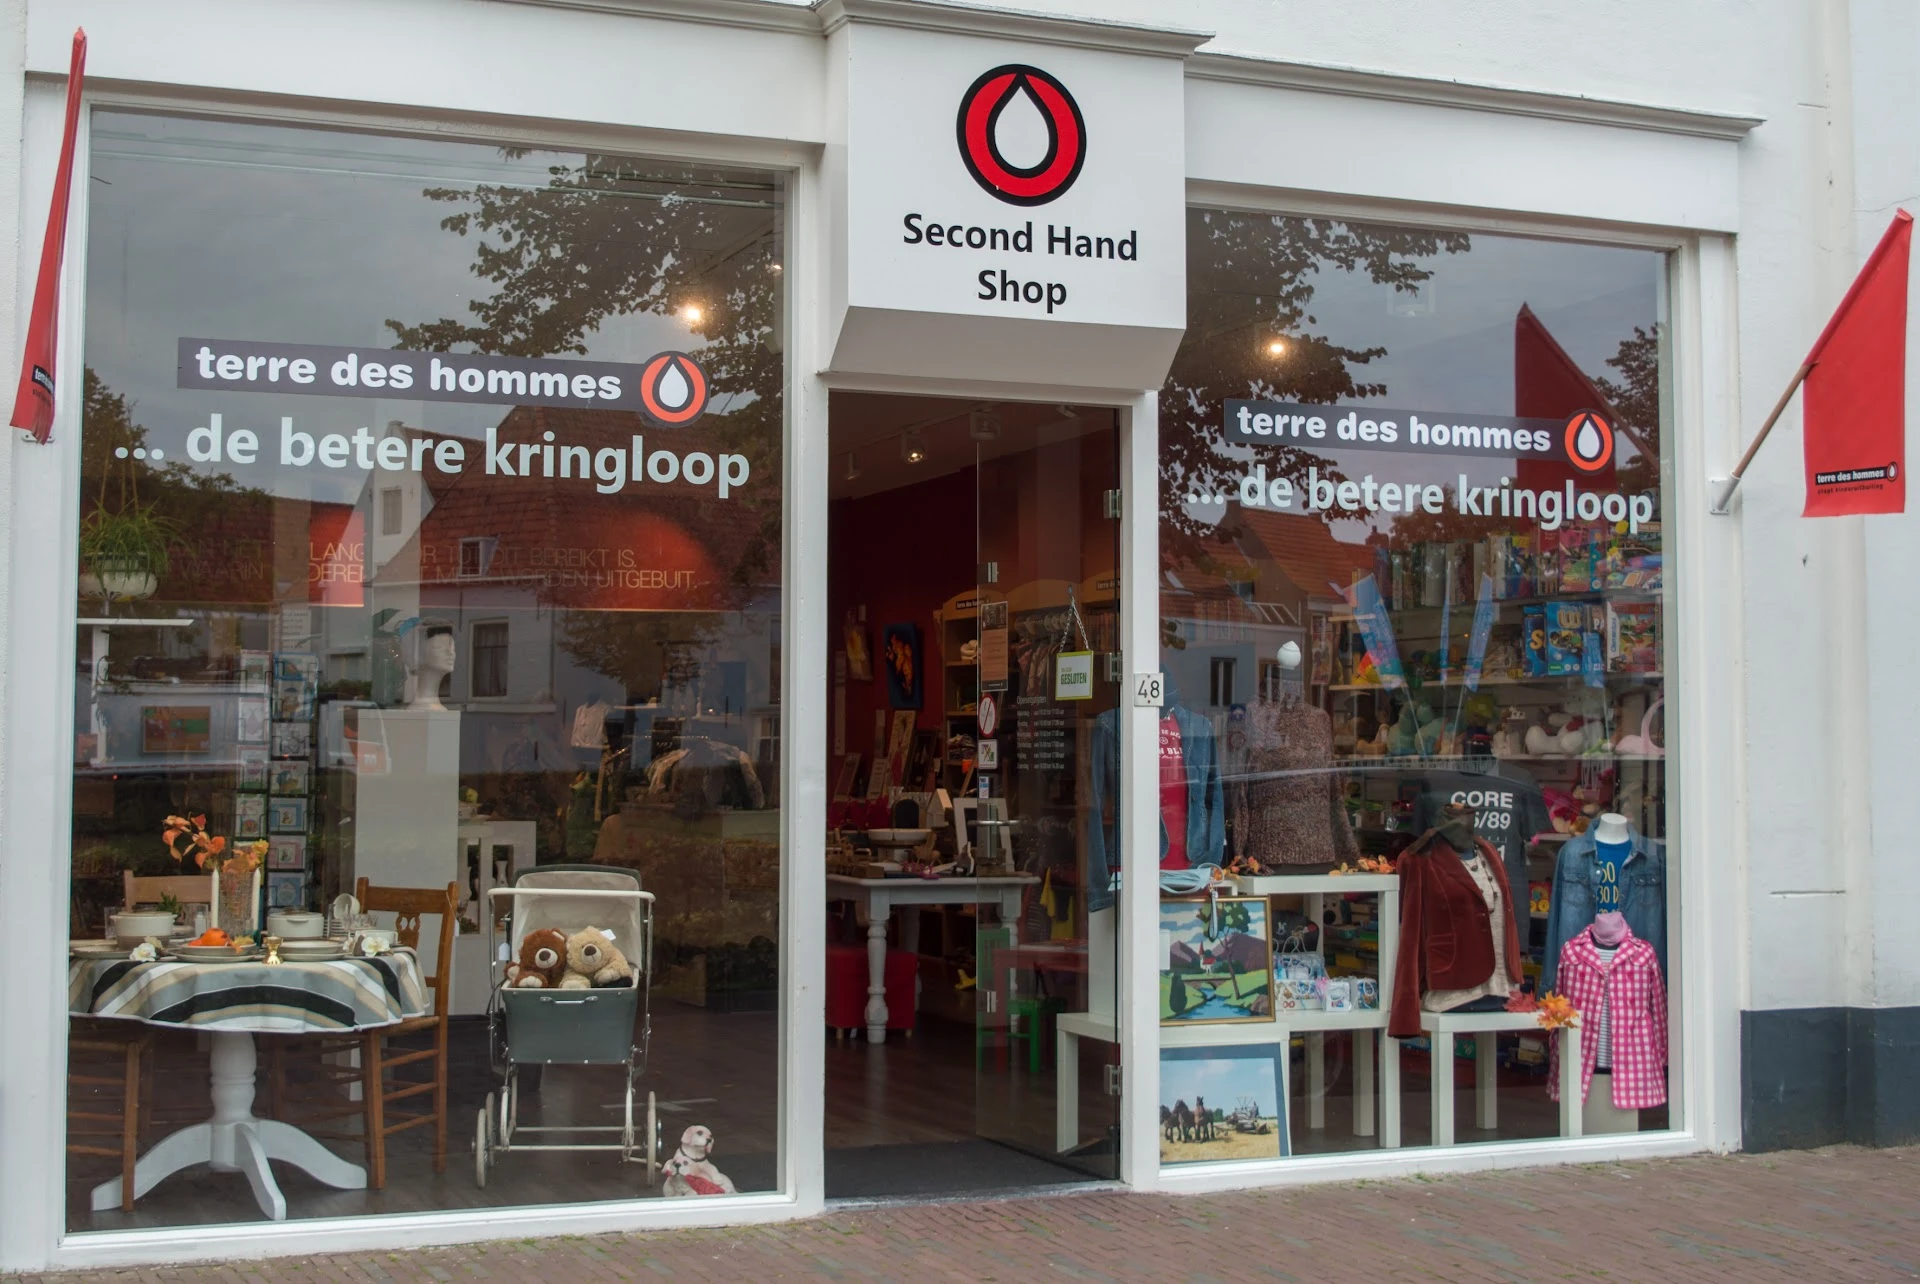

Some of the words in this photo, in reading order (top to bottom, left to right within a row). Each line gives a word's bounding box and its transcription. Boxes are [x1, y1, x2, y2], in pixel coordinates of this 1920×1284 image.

[903, 213, 1033, 253] Second
[1047, 224, 1137, 261] Hand
[978, 269, 1067, 314] Shop
[195, 346, 317, 384] terre
[330, 353, 414, 389] des
[430, 357, 622, 400] hommes
[1236, 406, 1327, 439] terre
[1336, 411, 1398, 443] des
[1409, 415, 1551, 451] hommes
[186, 412, 259, 464] de
[280, 416, 465, 473] betere
[485, 427, 750, 499] kringloop
[1817, 474, 1836, 484] terre
[1837, 472, 1851, 481] des
[1852, 469, 1884, 480] hommes
[1240, 464, 1294, 508] de
[1309, 466, 1444, 514] betere
[1458, 473, 1652, 534] kringloop
[530, 547, 611, 568] BEREIKT
[617, 549, 637, 568] IS.
[1060, 672, 1087, 685] GESLOTEN
[1138, 680, 1160, 699] 48
